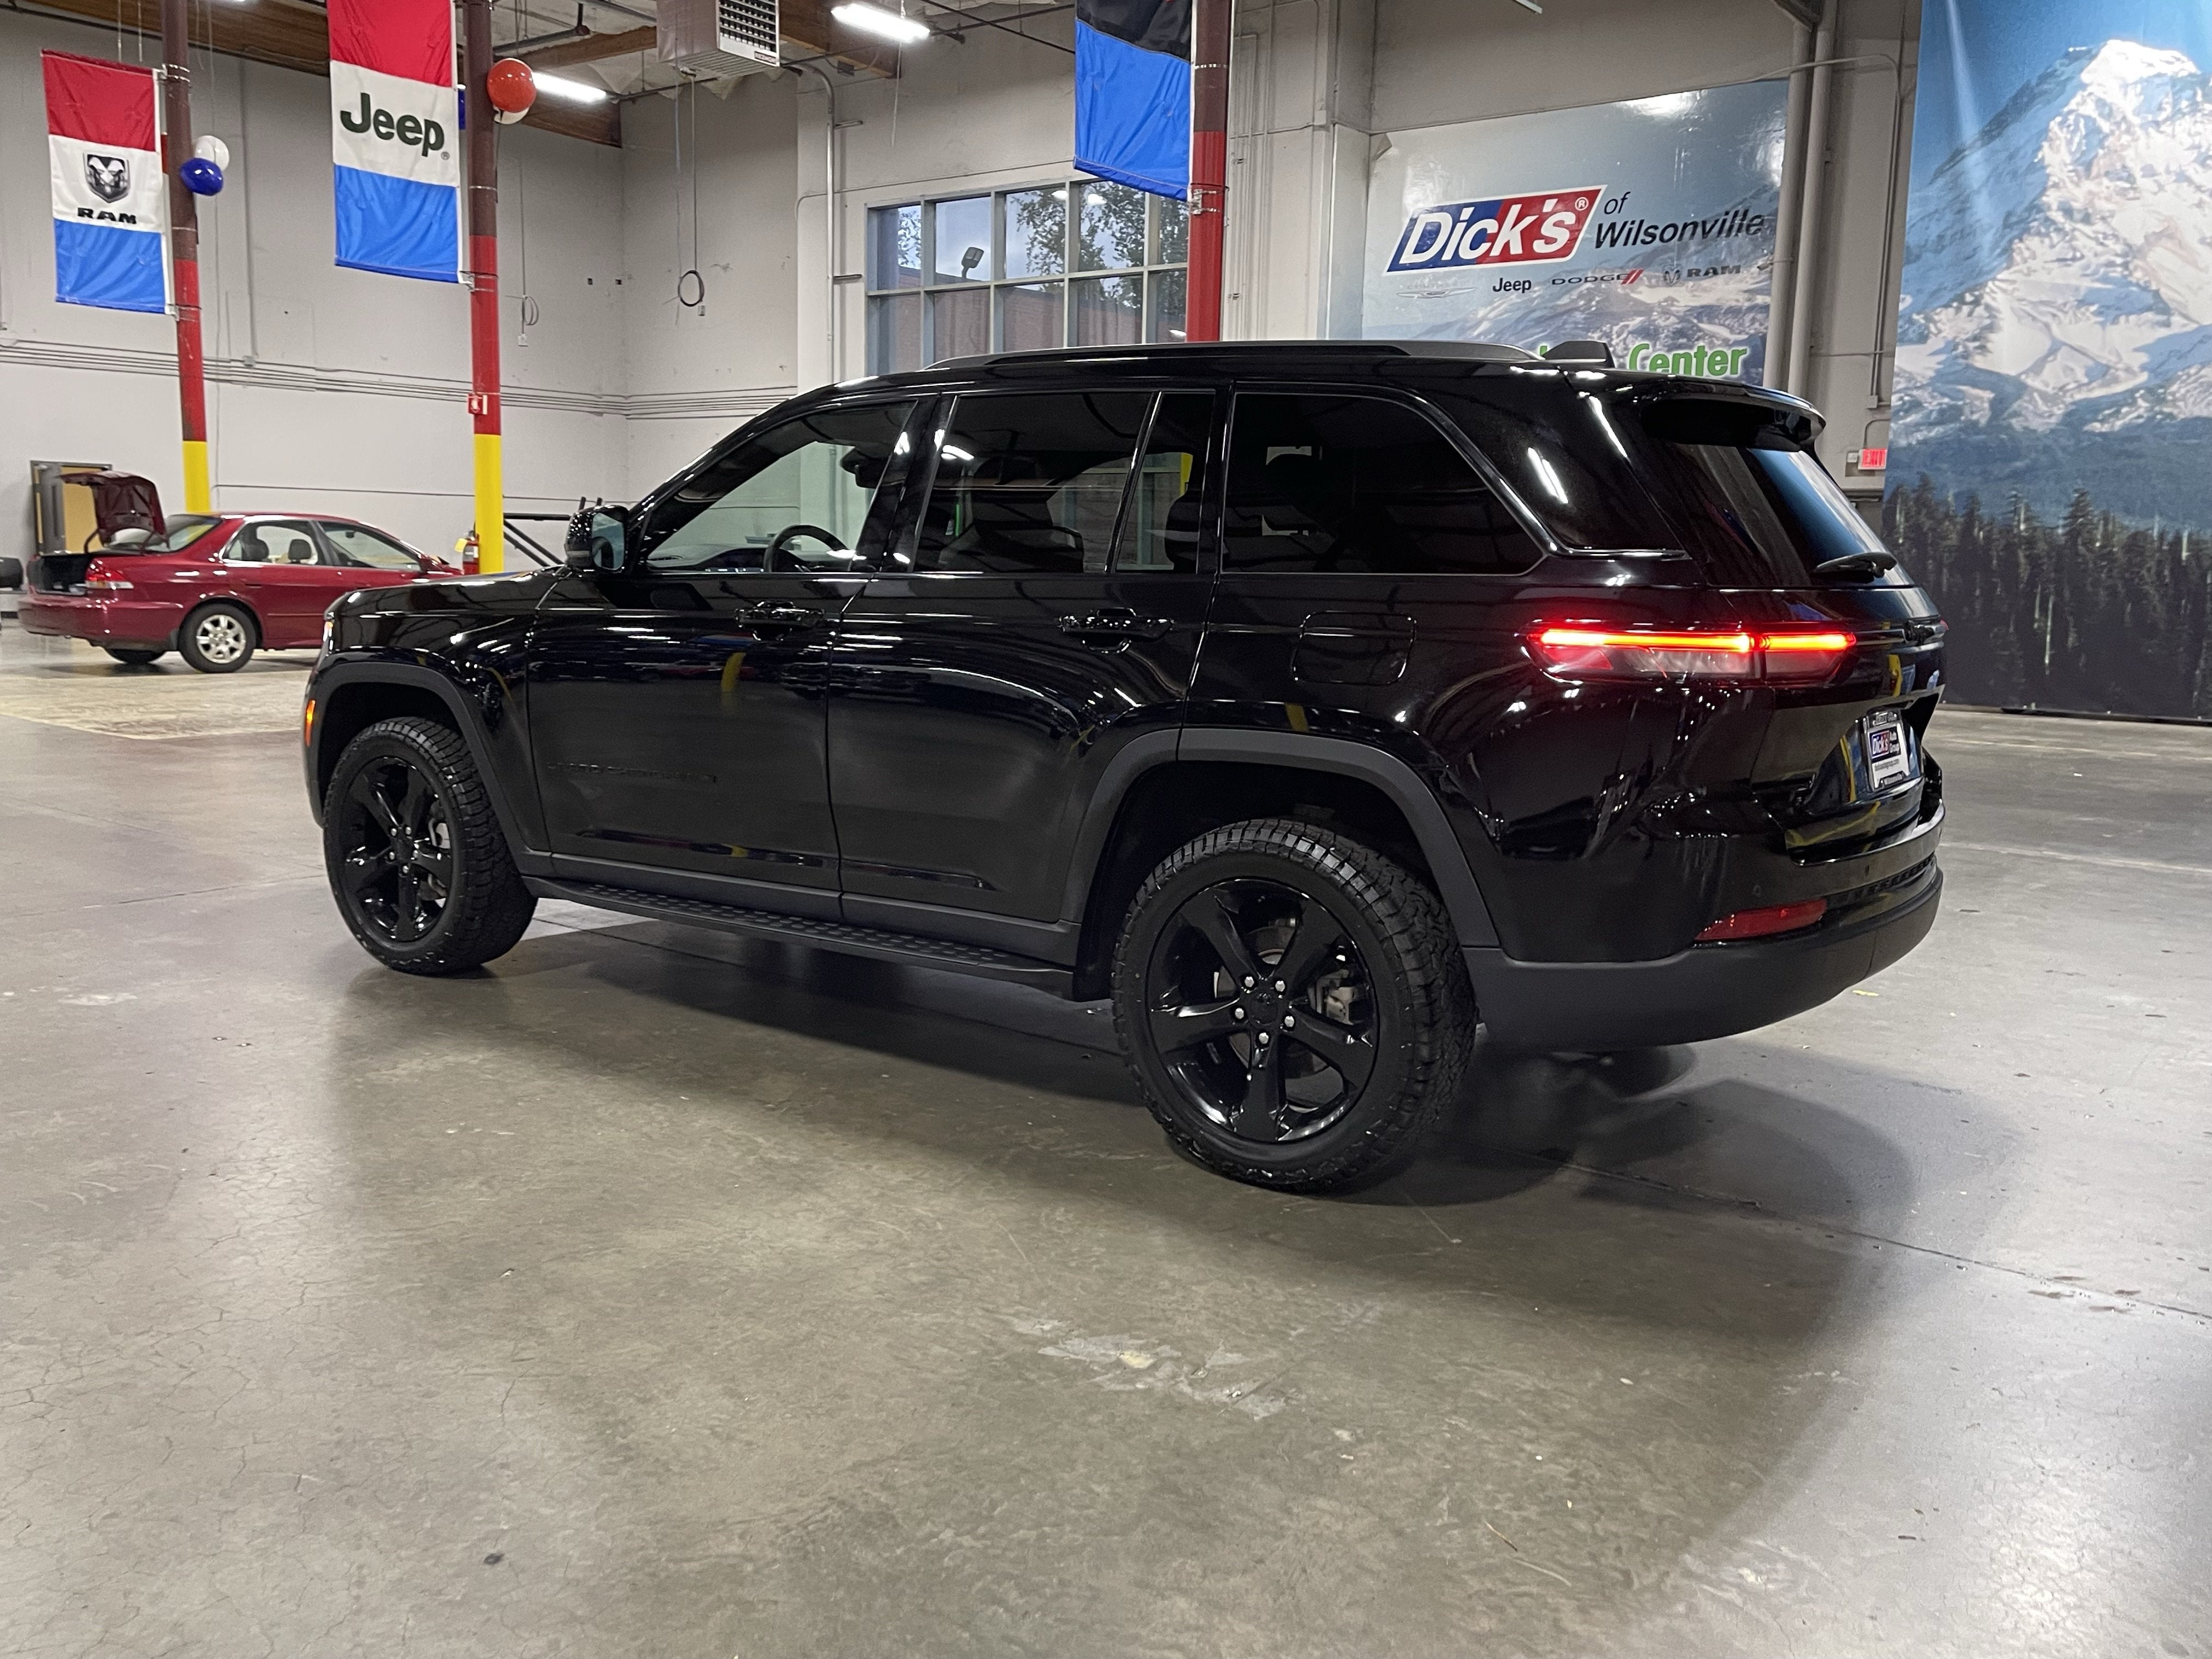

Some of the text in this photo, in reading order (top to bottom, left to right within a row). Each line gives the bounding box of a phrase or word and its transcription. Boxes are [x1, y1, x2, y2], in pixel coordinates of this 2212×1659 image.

[340, 92, 445, 157] Jeep
[77, 207, 137, 224] RAM
[1398, 191, 1631, 264] Dick's of
[1595, 208, 1764, 249] Wilsonville
[1492, 264, 1741, 294] Jeep DODGE RAM
[1628, 343, 1747, 376] Center
[1863, 450, 1886, 466] EXIT
[1872, 734, 1889, 754] Dick's
